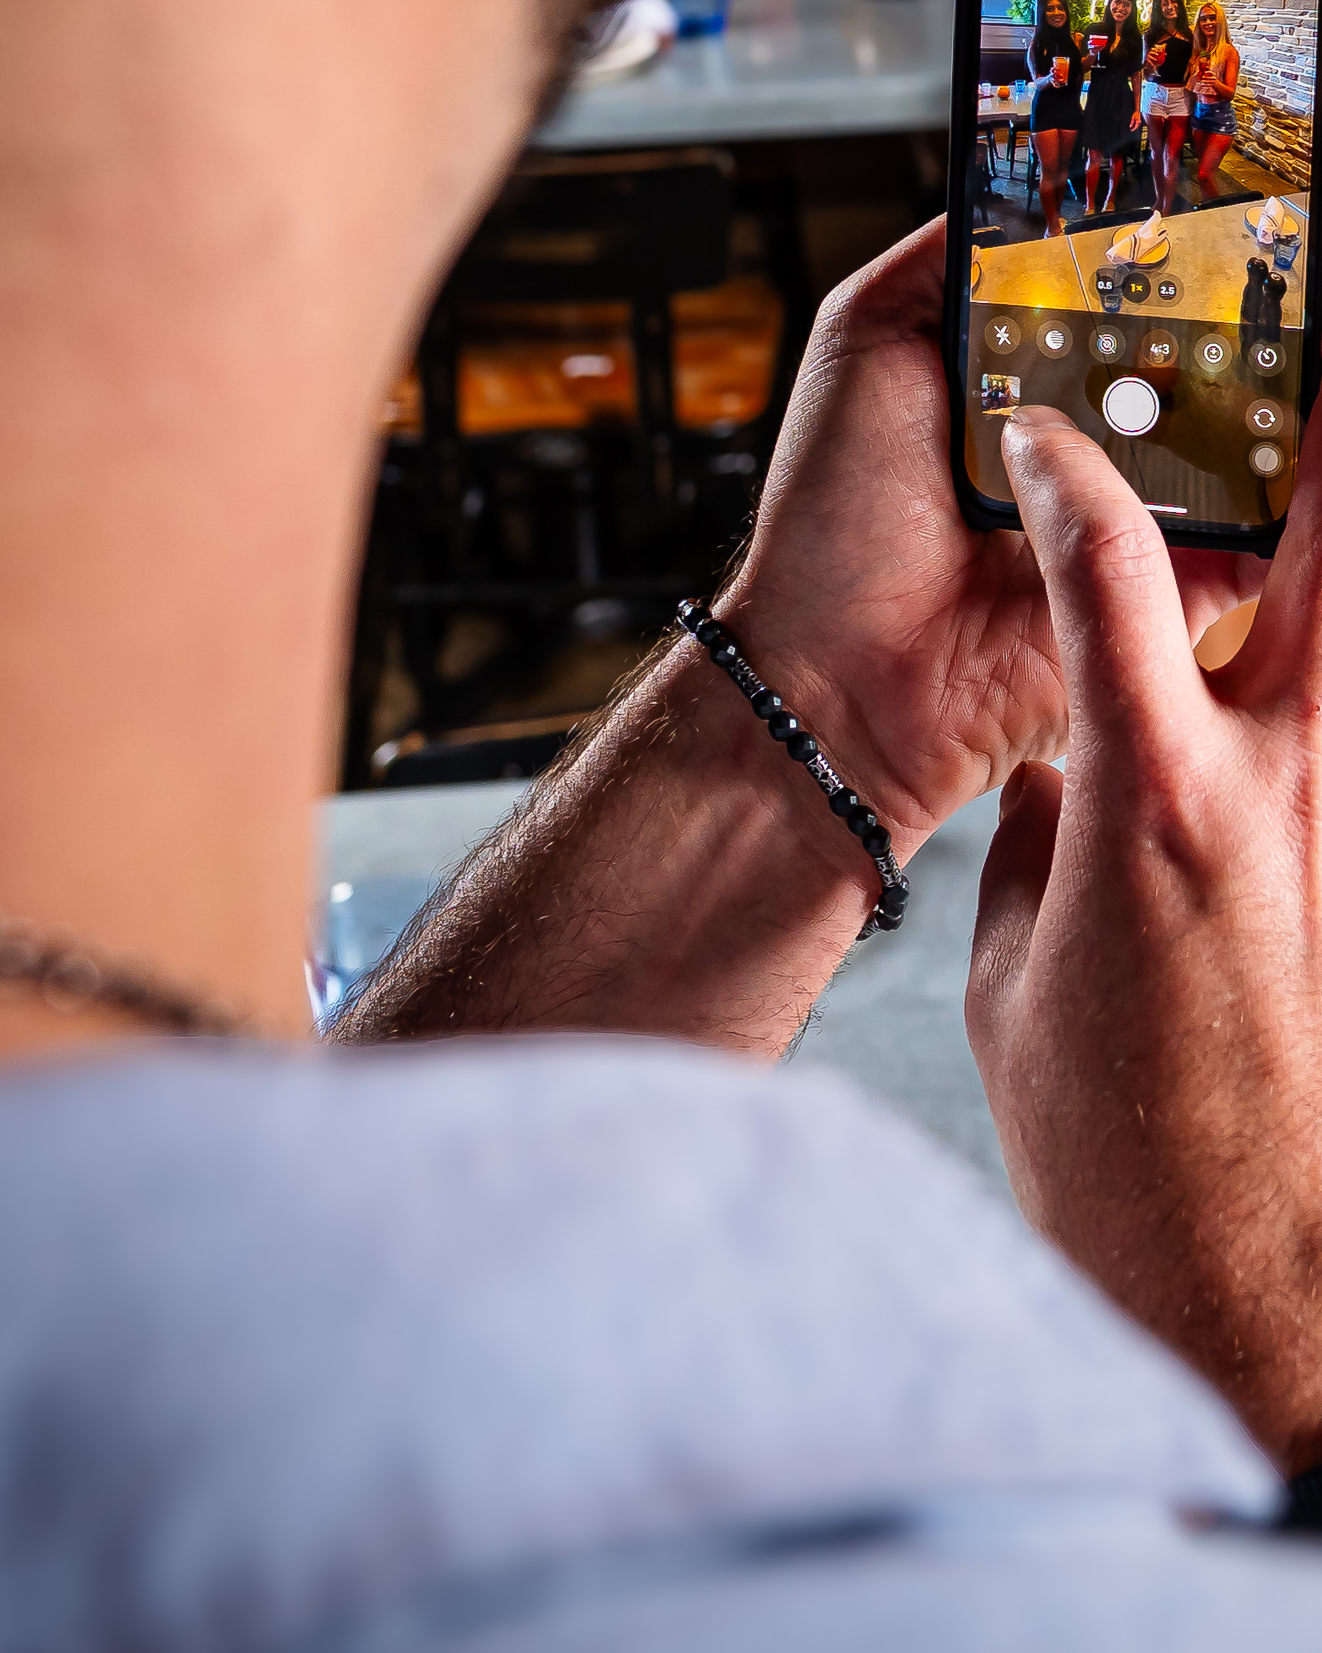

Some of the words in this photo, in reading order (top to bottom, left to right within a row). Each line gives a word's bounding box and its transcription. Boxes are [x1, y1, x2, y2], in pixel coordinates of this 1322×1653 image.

[1097, 281, 1113, 289] 0.5
[1160, 285, 1175, 295] 2.5
[1149, 343, 1170, 354] 4:3
